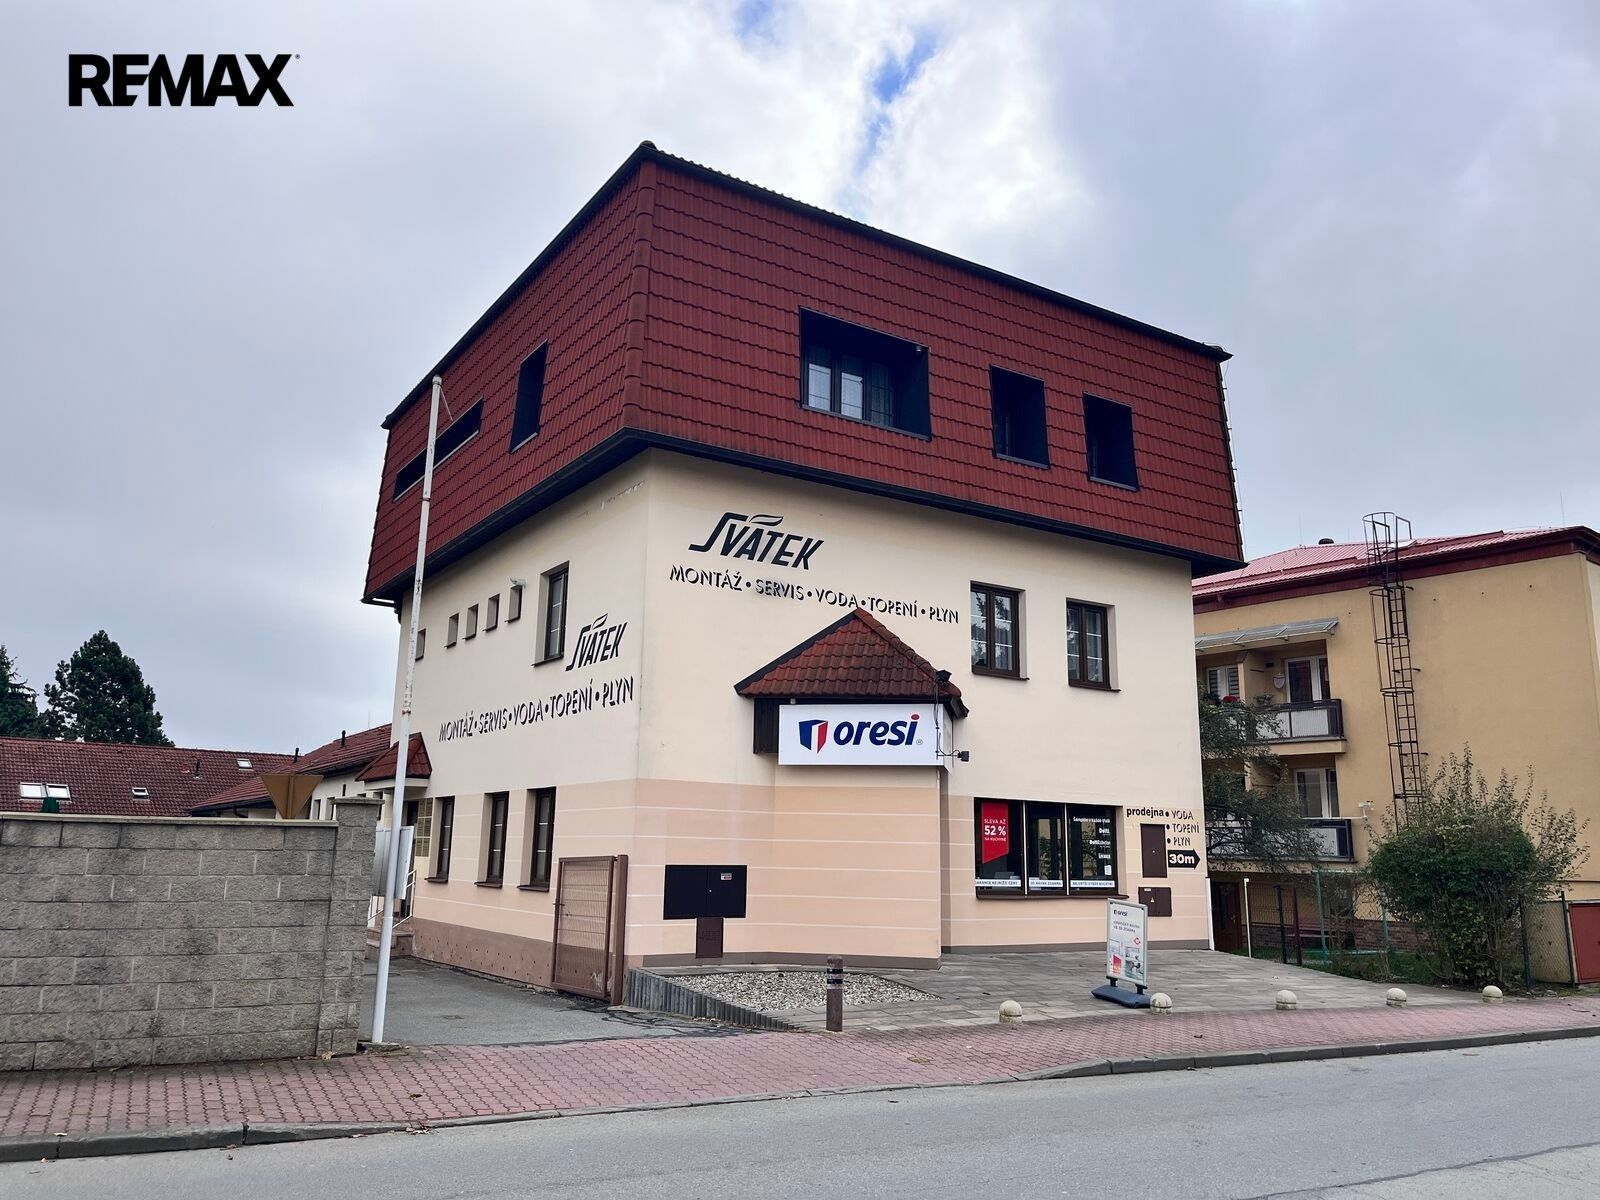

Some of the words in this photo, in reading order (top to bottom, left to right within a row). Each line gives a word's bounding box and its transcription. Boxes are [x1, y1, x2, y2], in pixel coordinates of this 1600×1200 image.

[670, 565, 742, 591] MONTÁŽ
[755, 579, 804, 601] SERVIS
[815, 588, 858, 608] VODA
[868, 597, 918, 618] TOPENÍ
[930, 606, 959, 624] PLYN
[439, 710, 475, 743] MONTÁŽ
[478, 707, 508, 735] SERVIS
[512, 699, 544, 726] VODA
[550, 678, 593, 719] TOPENÍ
[602, 676, 634, 707] PLYN
[833, 713, 920, 746] oresi
[1126, 807, 1164, 818] prodejna
[1171, 810, 1194, 820] VODA
[984, 825, 996, 836] 52
[997, 825, 1007, 836] %
[1172, 821, 1200, 834] TOPENÍ
[1173, 836, 1191, 846] PLYN
[1169, 853, 1195, 864] 30m
